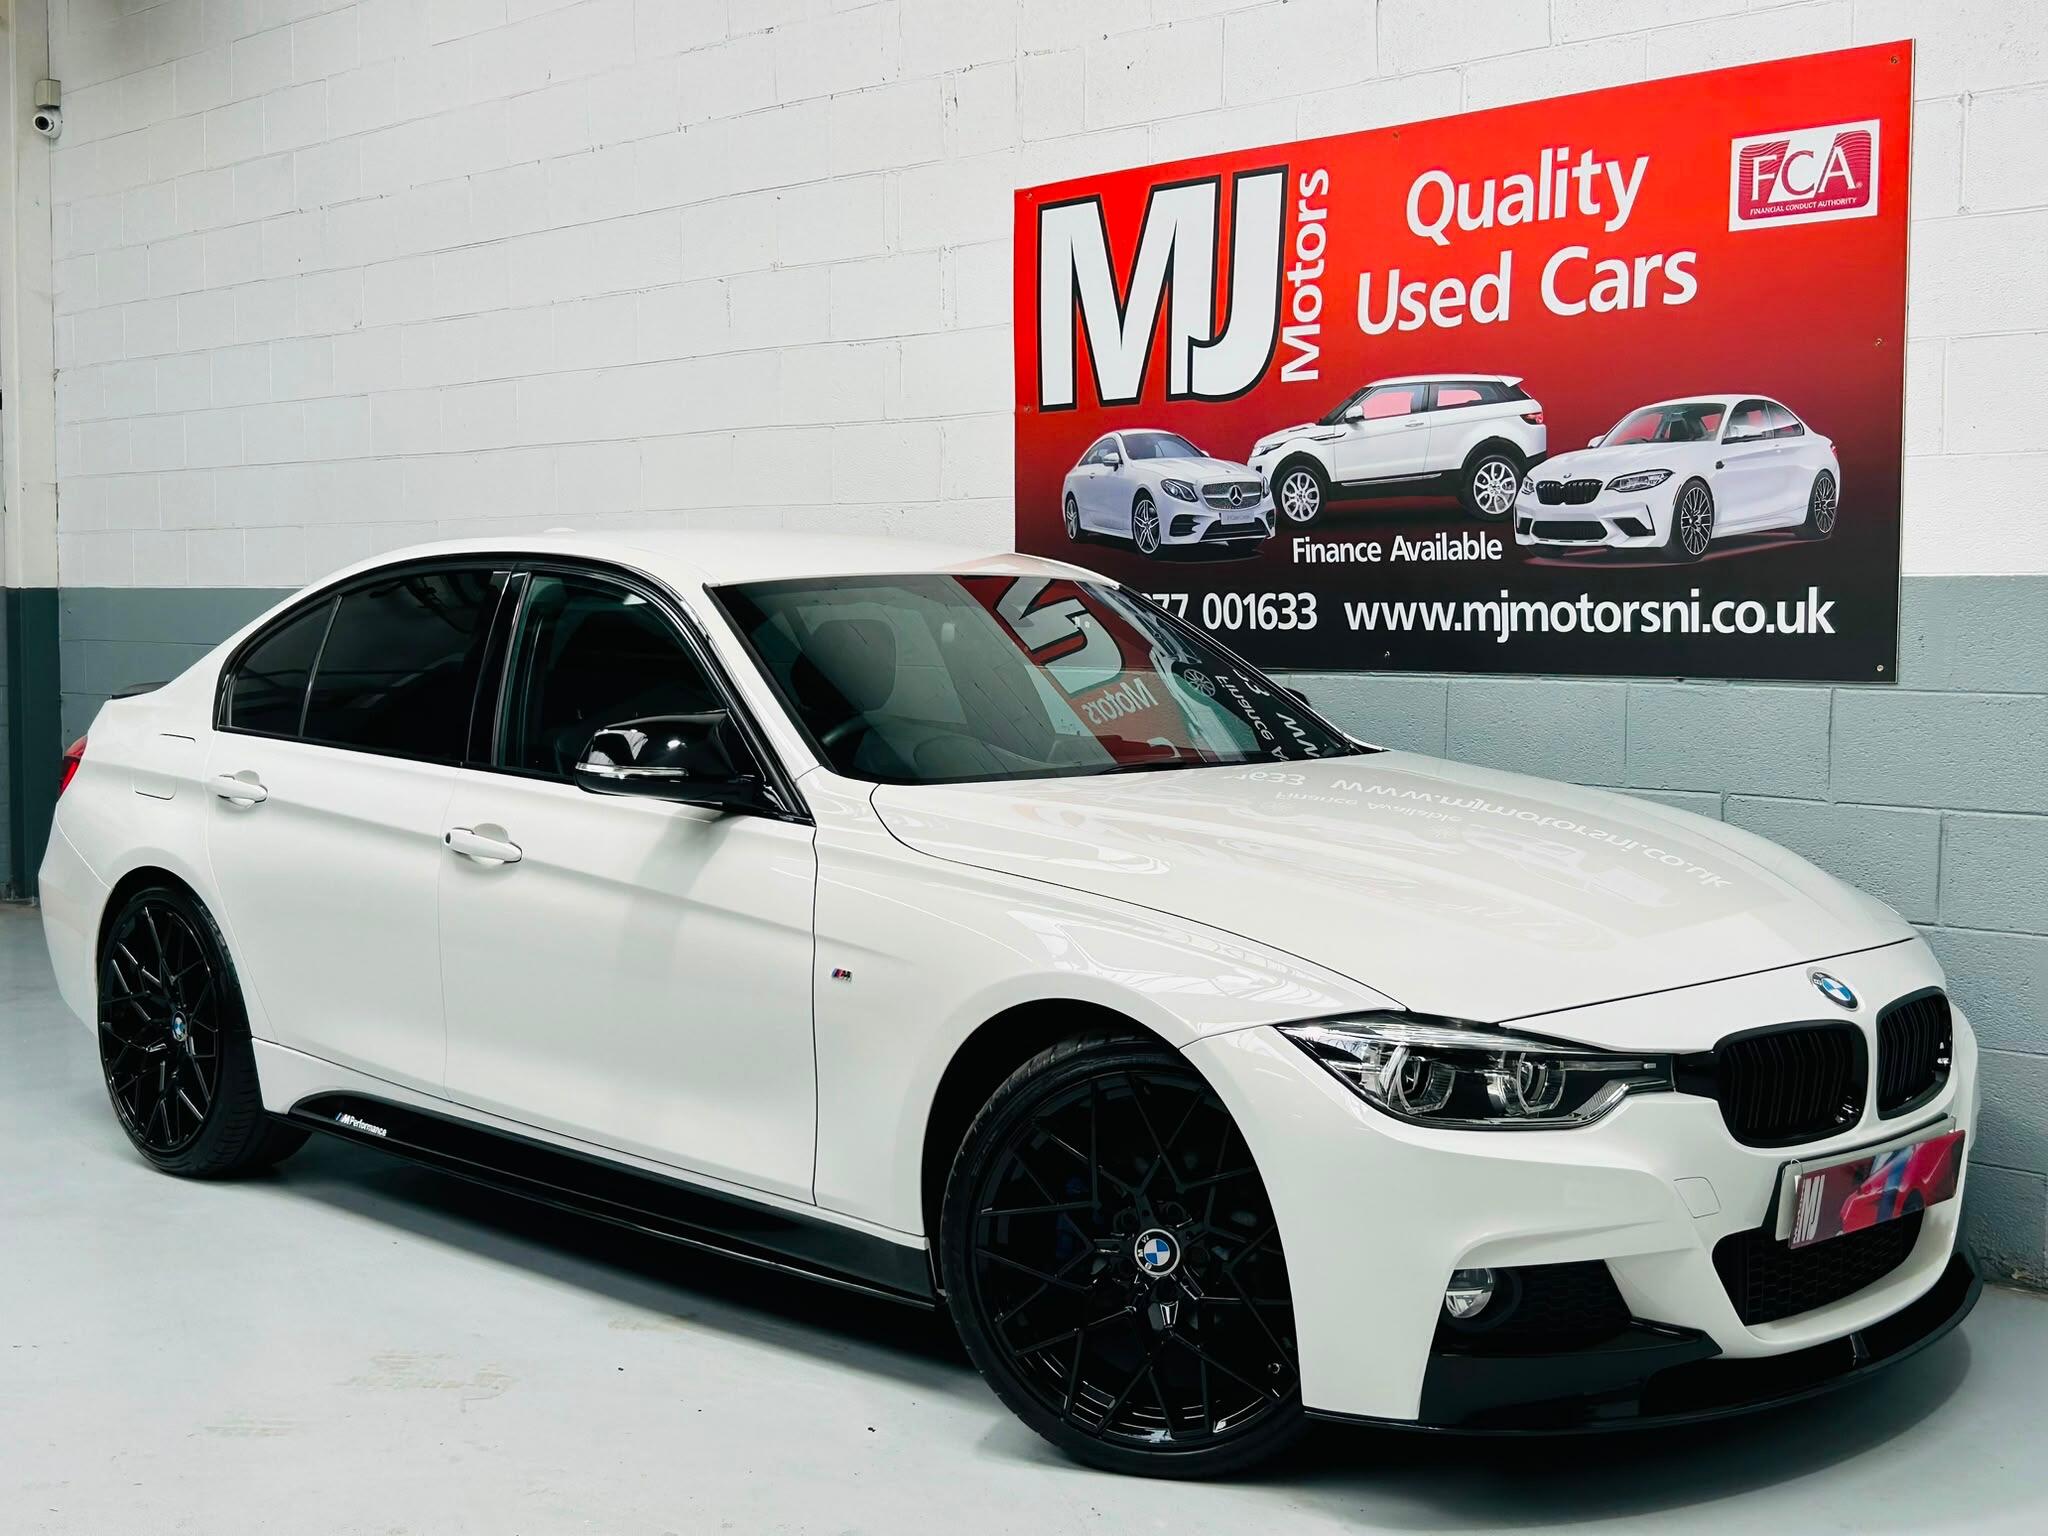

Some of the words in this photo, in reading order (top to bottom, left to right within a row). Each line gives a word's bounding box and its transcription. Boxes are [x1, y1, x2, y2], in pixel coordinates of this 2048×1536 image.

[1406, 146, 1650, 247] Quality
[1749, 204, 1785, 216] FINANCIAL
[1785, 201, 1817, 212] CONDUCT
[1817, 197, 1857, 209] AUTHORITY
[1751, 145, 1858, 202] FCA
[1038, 164, 1289, 413] MJ
[1280, 168, 1330, 383] Motors
[1357, 251, 1512, 336] Used
[1540, 245, 1698, 316] Cars
[1292, 536, 1382, 564] Finance
[1389, 530, 1503, 562] Available
[1202, 592, 1318, 630] 001633
[1344, 586, 1836, 643] www.mjmotorsni.co.uk
